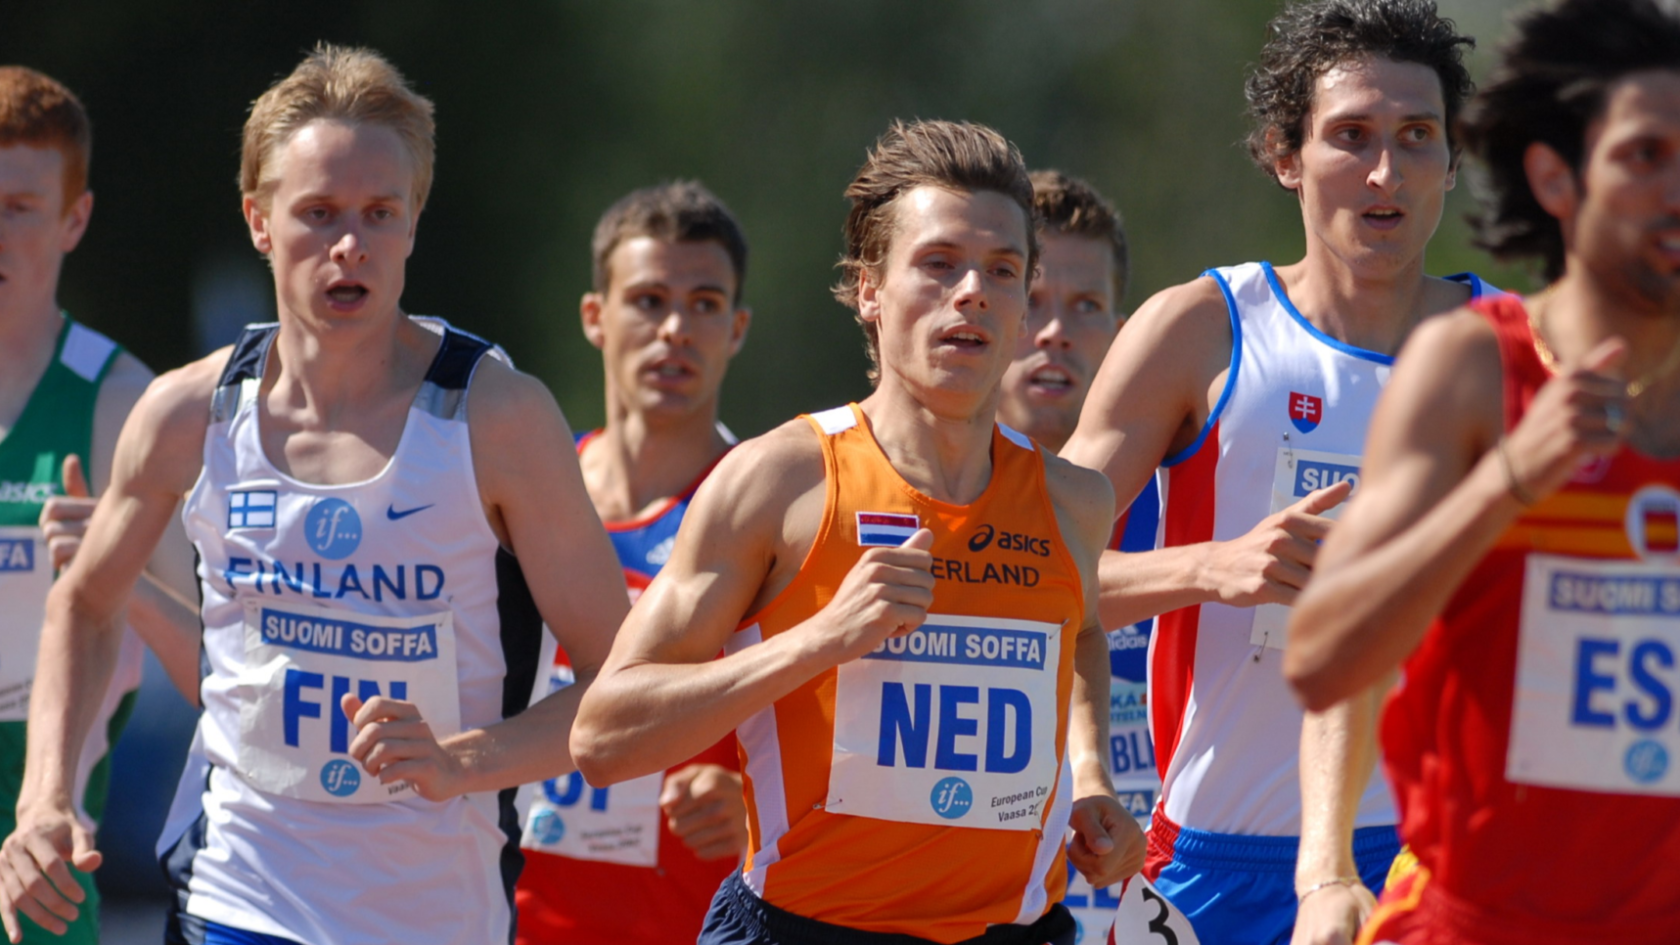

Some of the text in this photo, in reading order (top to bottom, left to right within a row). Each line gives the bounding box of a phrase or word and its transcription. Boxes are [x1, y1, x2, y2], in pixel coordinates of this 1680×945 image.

[997, 531, 1051, 557] asics
[223, 556, 445, 602] FINLAND
[931, 557, 1040, 588] ERLAND
[265, 615, 432, 658] SUOMI SOFFA
[965, 634, 1041, 663] SOFFA
[1570, 635, 1680, 734] ES
[876, 681, 1033, 774] NED
[991, 789, 1034, 808] European
[998, 807, 1027, 823] Vaasa
